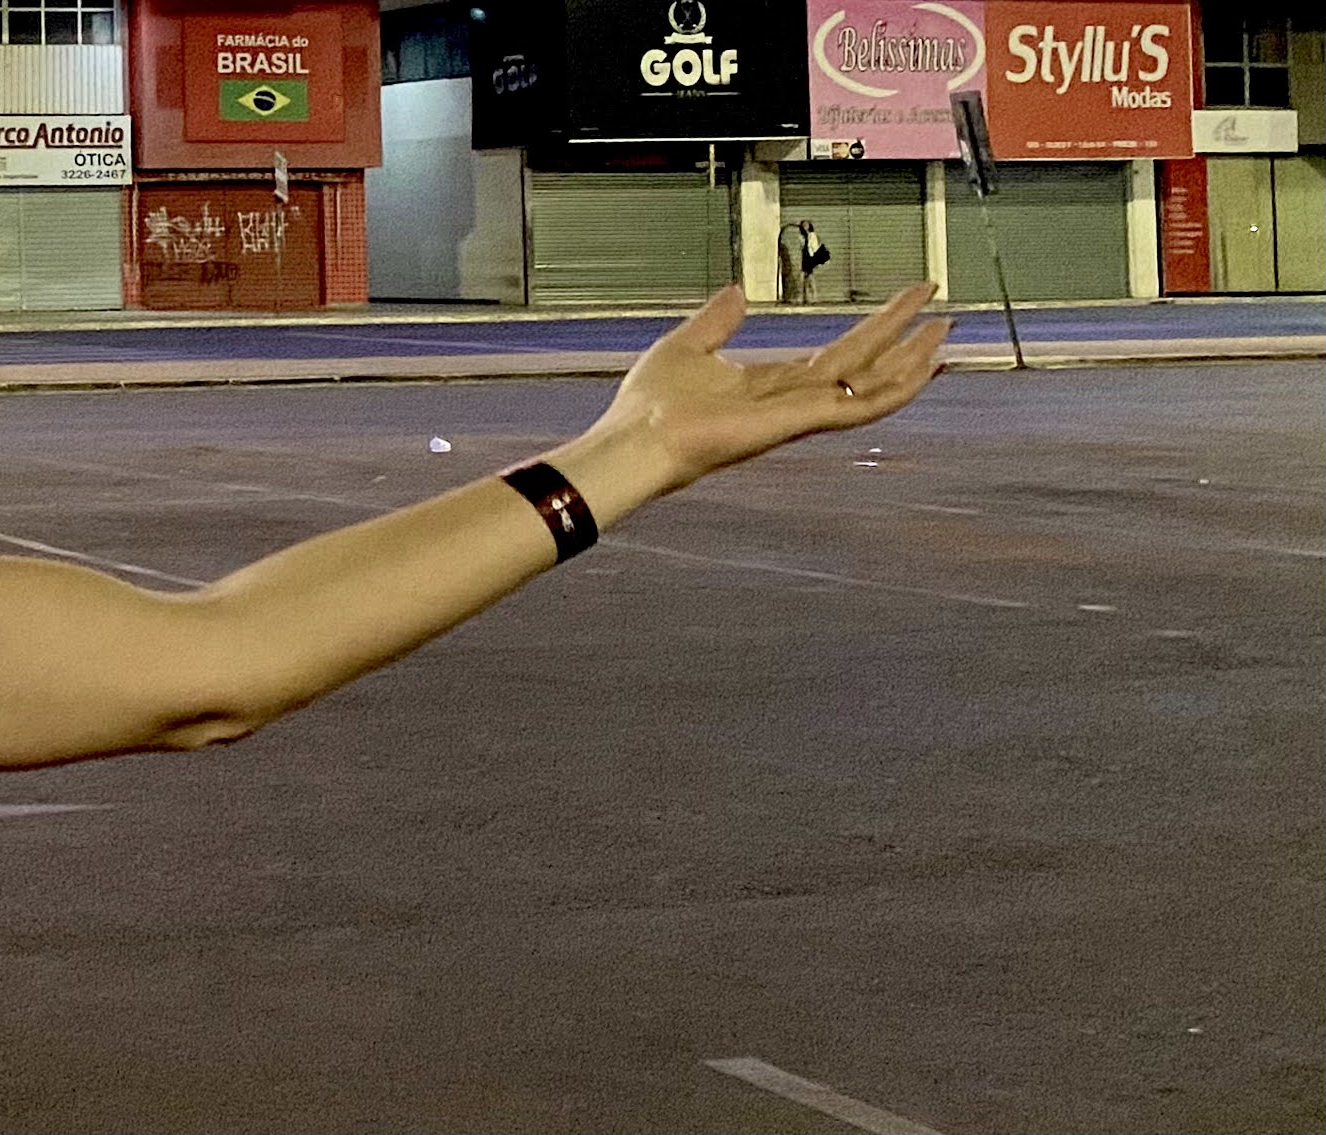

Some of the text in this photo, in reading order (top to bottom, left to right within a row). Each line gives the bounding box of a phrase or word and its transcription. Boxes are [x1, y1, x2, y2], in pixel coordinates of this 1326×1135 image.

[216, 32, 309, 48] FARMÁCIA do
[216, 52, 310, 74] BRASIL
[640, 49, 739, 87] GOLF
[1111, 85, 1172, 109] Modas
[32, 121, 124, 148] Antonio
[74, 150, 127, 167] ÓTICA
